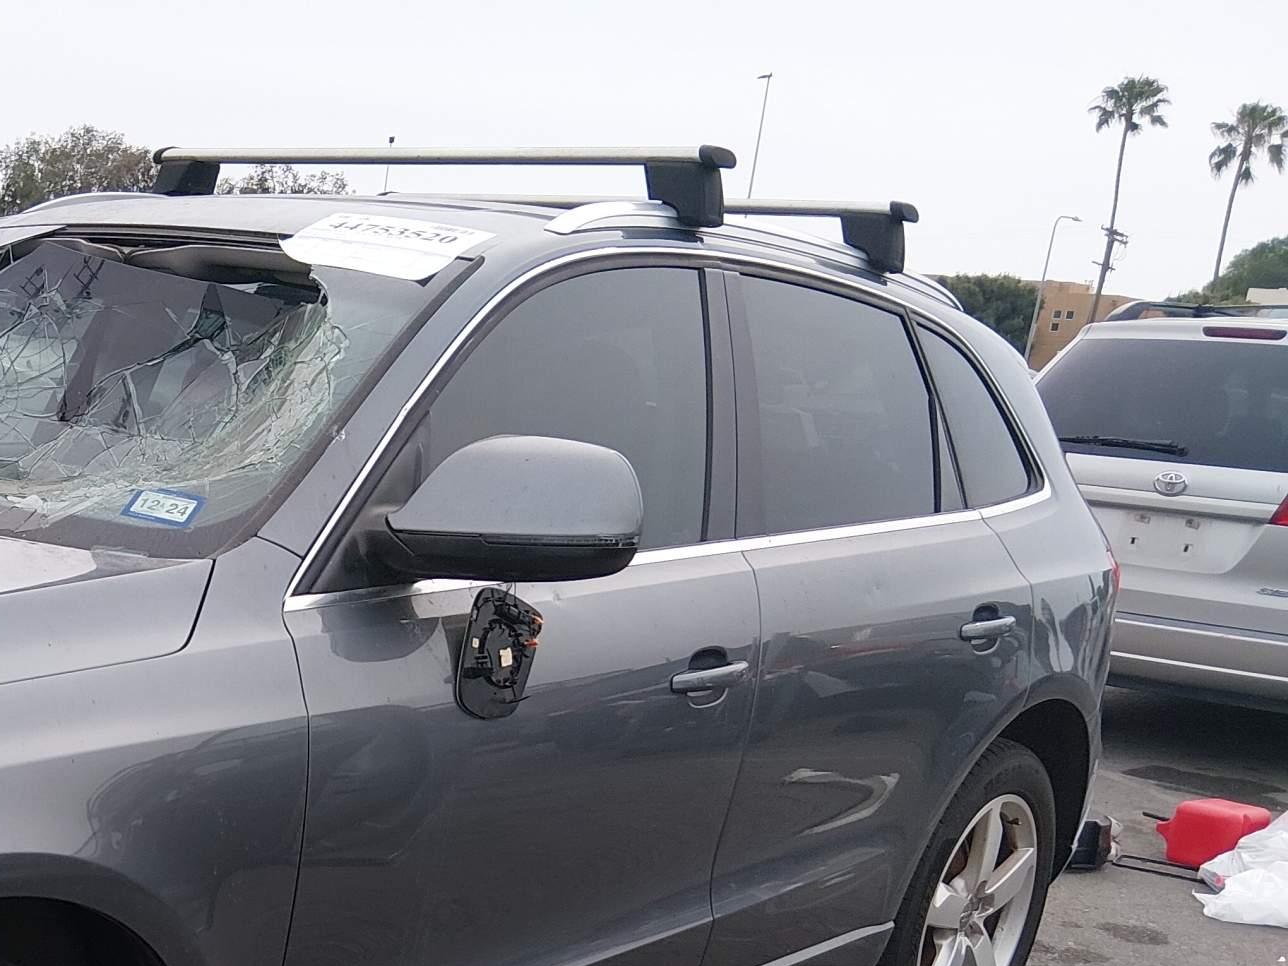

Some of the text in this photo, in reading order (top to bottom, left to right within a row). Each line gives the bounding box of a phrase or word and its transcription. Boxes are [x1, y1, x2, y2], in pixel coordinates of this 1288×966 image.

[329, 221, 459, 244] 44753520
[139, 497, 161, 511] 12
[165, 503, 189, 517] 24
